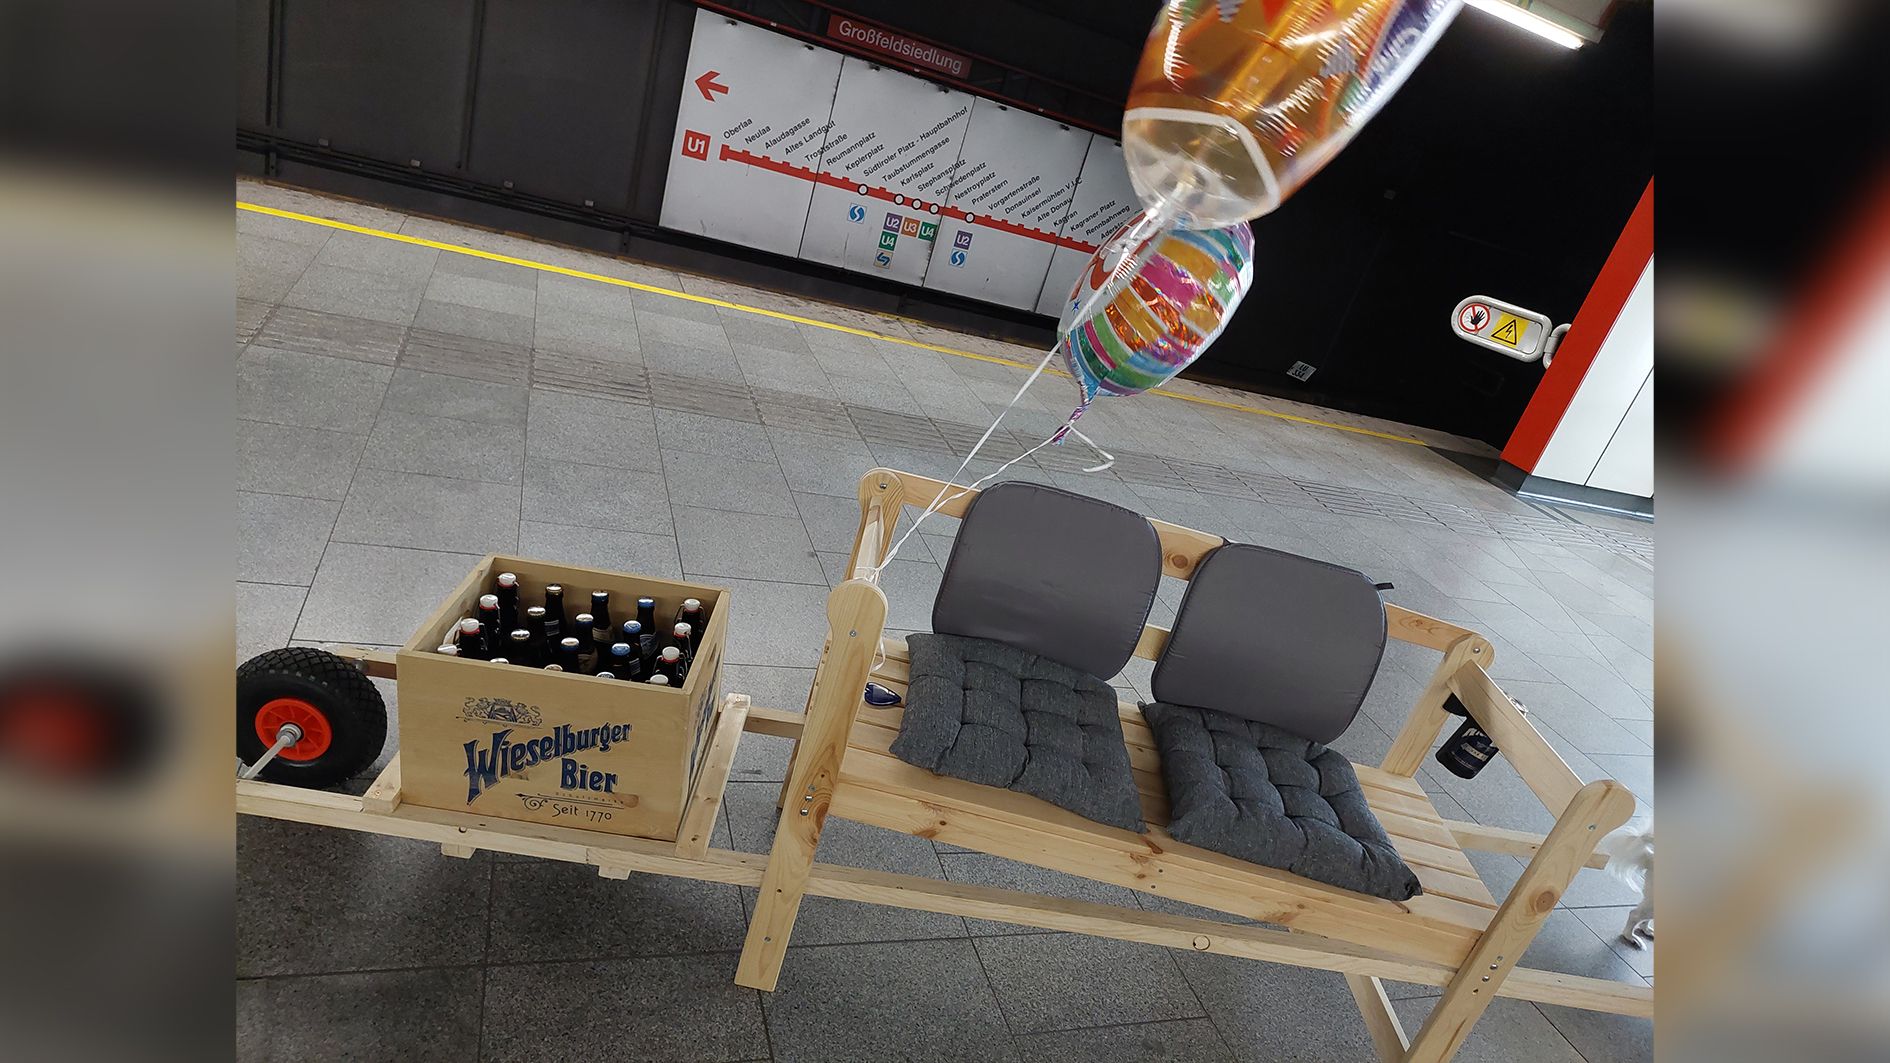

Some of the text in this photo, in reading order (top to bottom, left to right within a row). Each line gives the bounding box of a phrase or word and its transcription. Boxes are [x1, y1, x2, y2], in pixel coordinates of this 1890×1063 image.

[839, 20, 962, 74] Großfeldsiedlung
[723, 118, 753, 140] Oberlaa
[745, 125, 771, 145] Neulaa
[764, 117, 811, 150] Alaudagasse
[784, 120, 836, 155] Altes Landgut
[863, 151, 898, 177] Südtiroler
[897, 140, 916, 156] Platz
[919, 106, 968, 143] Hauptbahnhof
[687, 136, 706, 154] U1
[804, 132, 848, 162] Troststraße
[826, 131, 876, 166] Reumannplatz
[845, 143, 885, 171] Keplerplatz
[882, 136, 950, 183] Taubstummengasse
[900, 161, 935, 186] Karlsplatz
[917, 158, 967, 192] Stephansplatz
[935, 161, 987, 197] Schwedenplatz
[954, 171, 997, 201] Nestroyplatz
[971, 179, 1009, 206] Praterstern
[988, 174, 1041, 211] Vorgartenstraße
[1005, 187, 1042, 215] Donauinsel
[1021, 188, 1066, 219] Kaisermühlen
[1037, 197, 1072, 223] Alte Donau
[1053, 209, 1079, 228] Kagran
[1070, 211, 1101, 232] Kagraner
[1099, 199, 1117, 214] Platz
[1085, 204, 1131, 236] Rennbahnweg
[881, 235, 895, 248] U4
[886, 217, 935, 238] U2 U3 U4
[956, 234, 970, 247] U2
[463, 721, 633, 806] Wieselburger
[560, 757, 619, 794] Bier
[552, 803, 613, 824] Seit 1770
